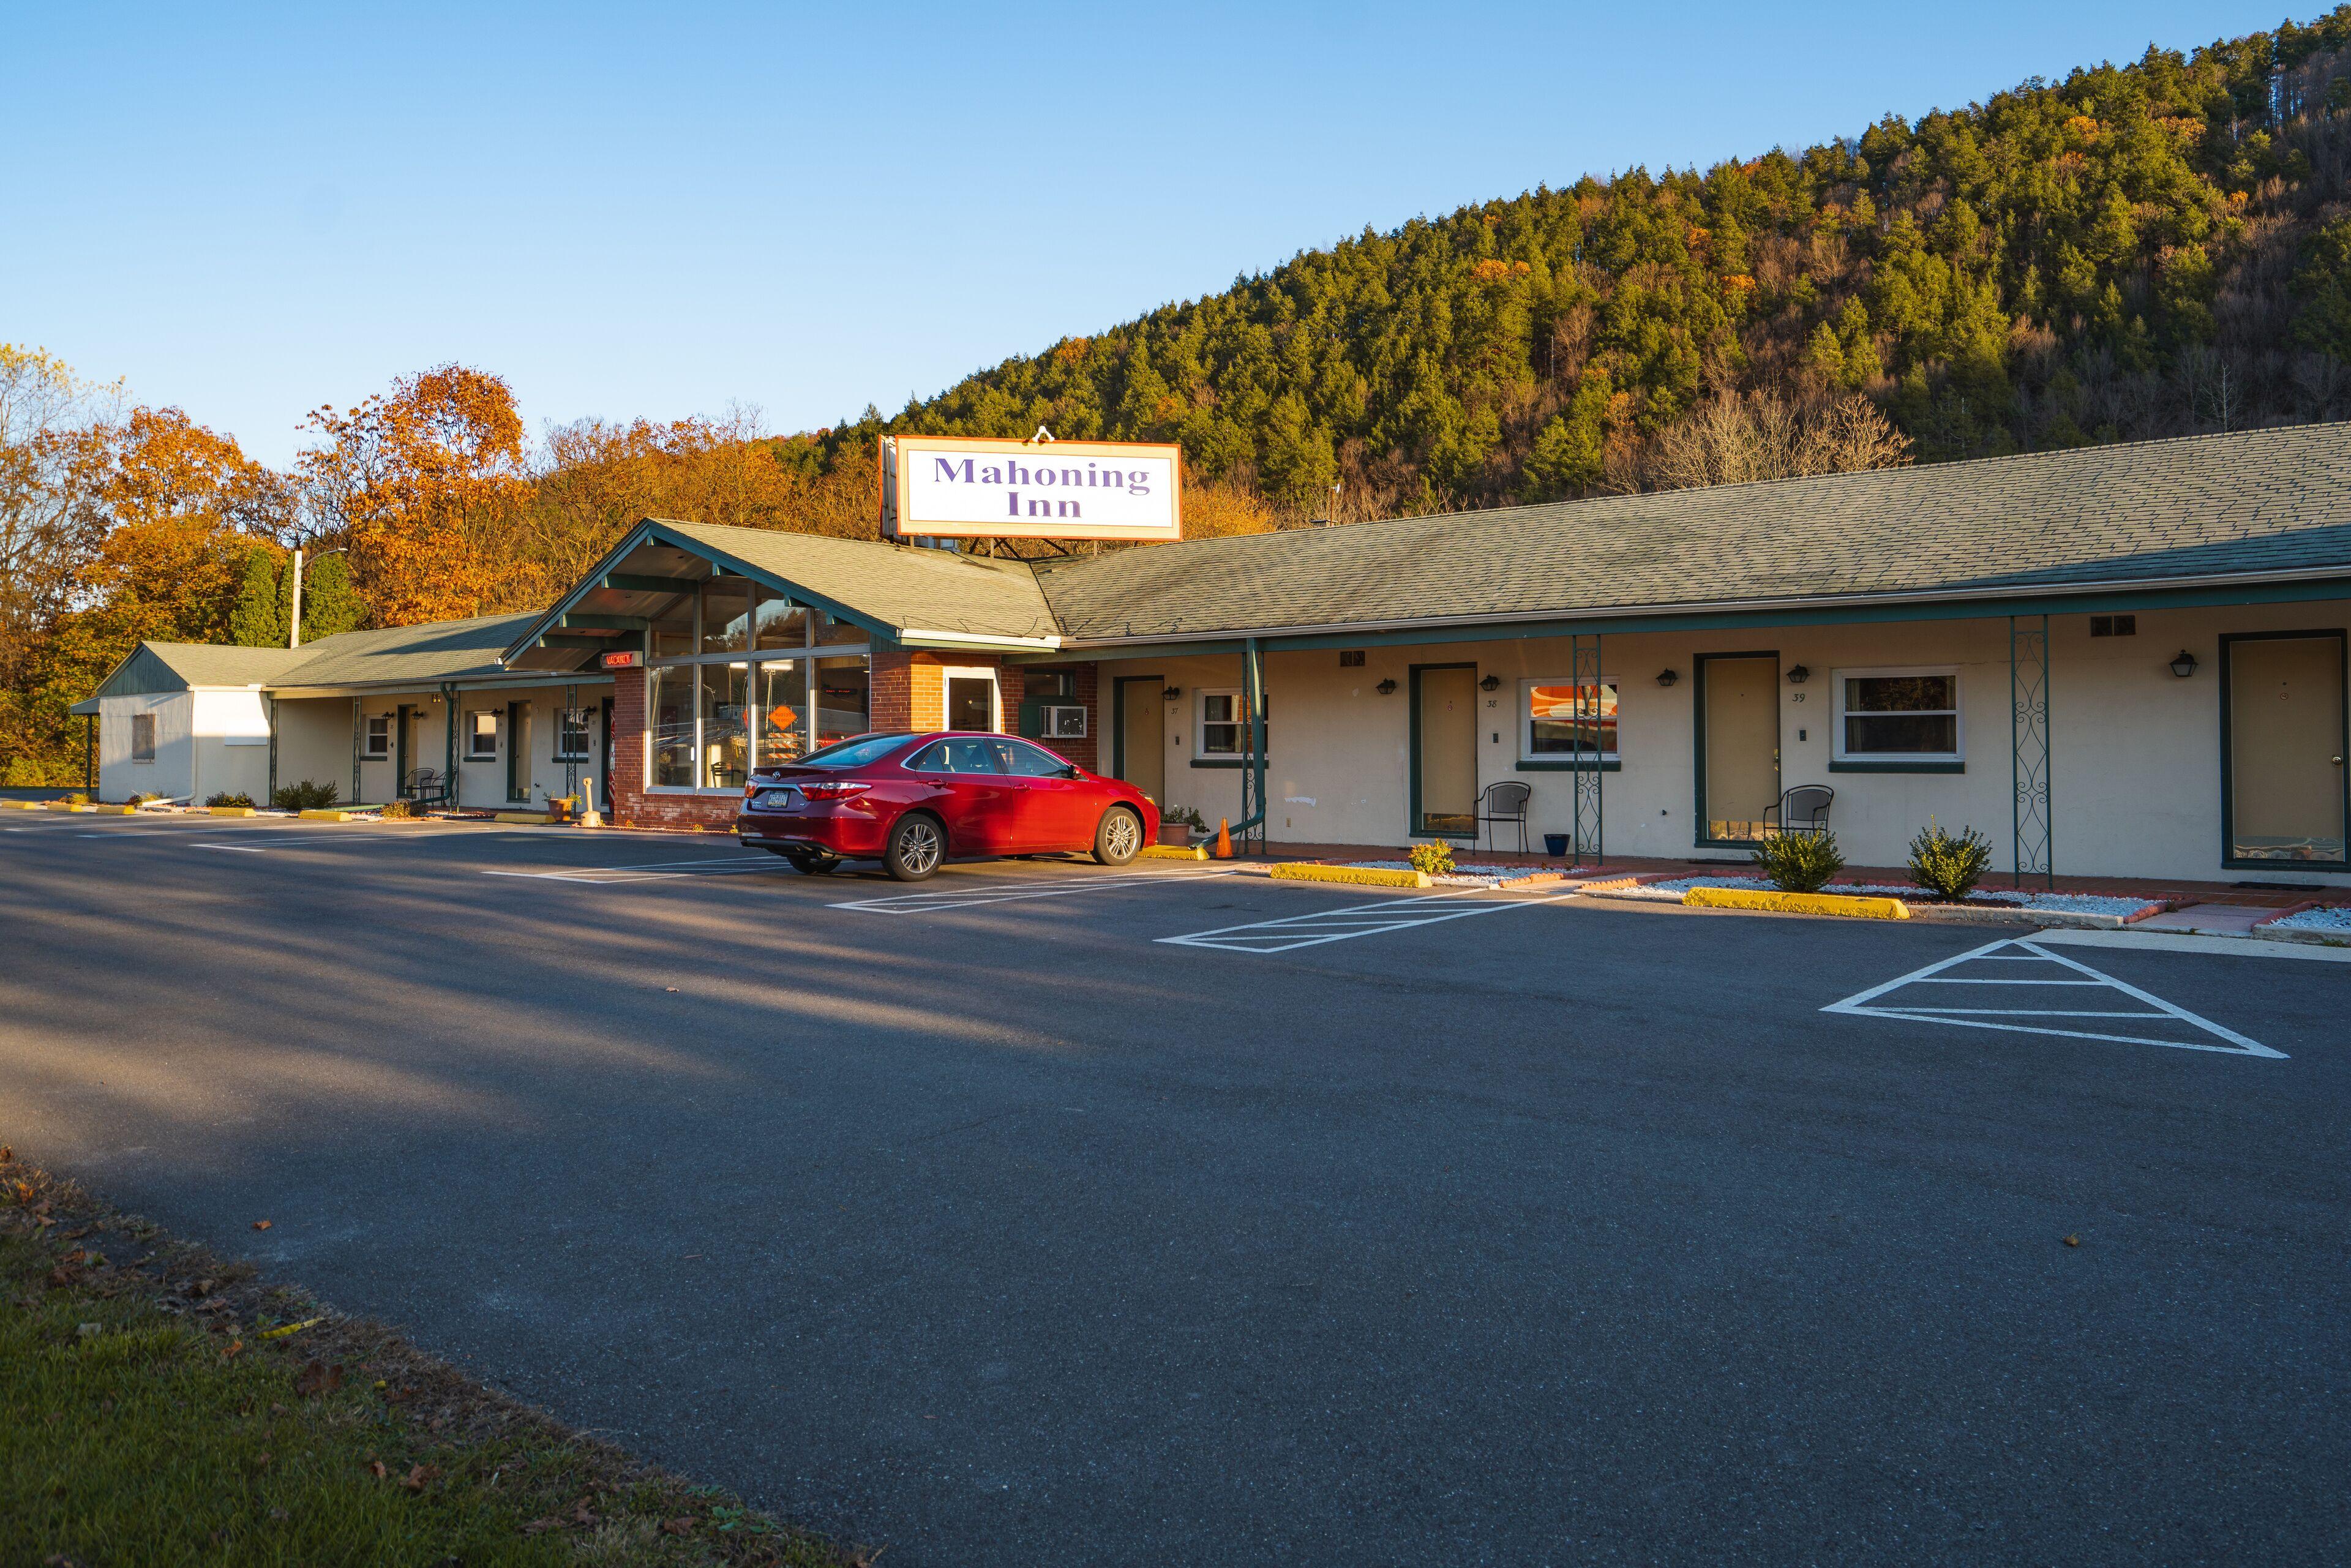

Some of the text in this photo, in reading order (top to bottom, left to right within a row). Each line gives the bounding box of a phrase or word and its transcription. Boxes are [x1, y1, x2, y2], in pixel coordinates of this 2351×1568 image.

[934, 458, 1150, 496] Mahoning
[1007, 491, 1082, 518] Inn
[606, 654, 630, 666] VACANCY
[1792, 693, 1805, 703] 39
